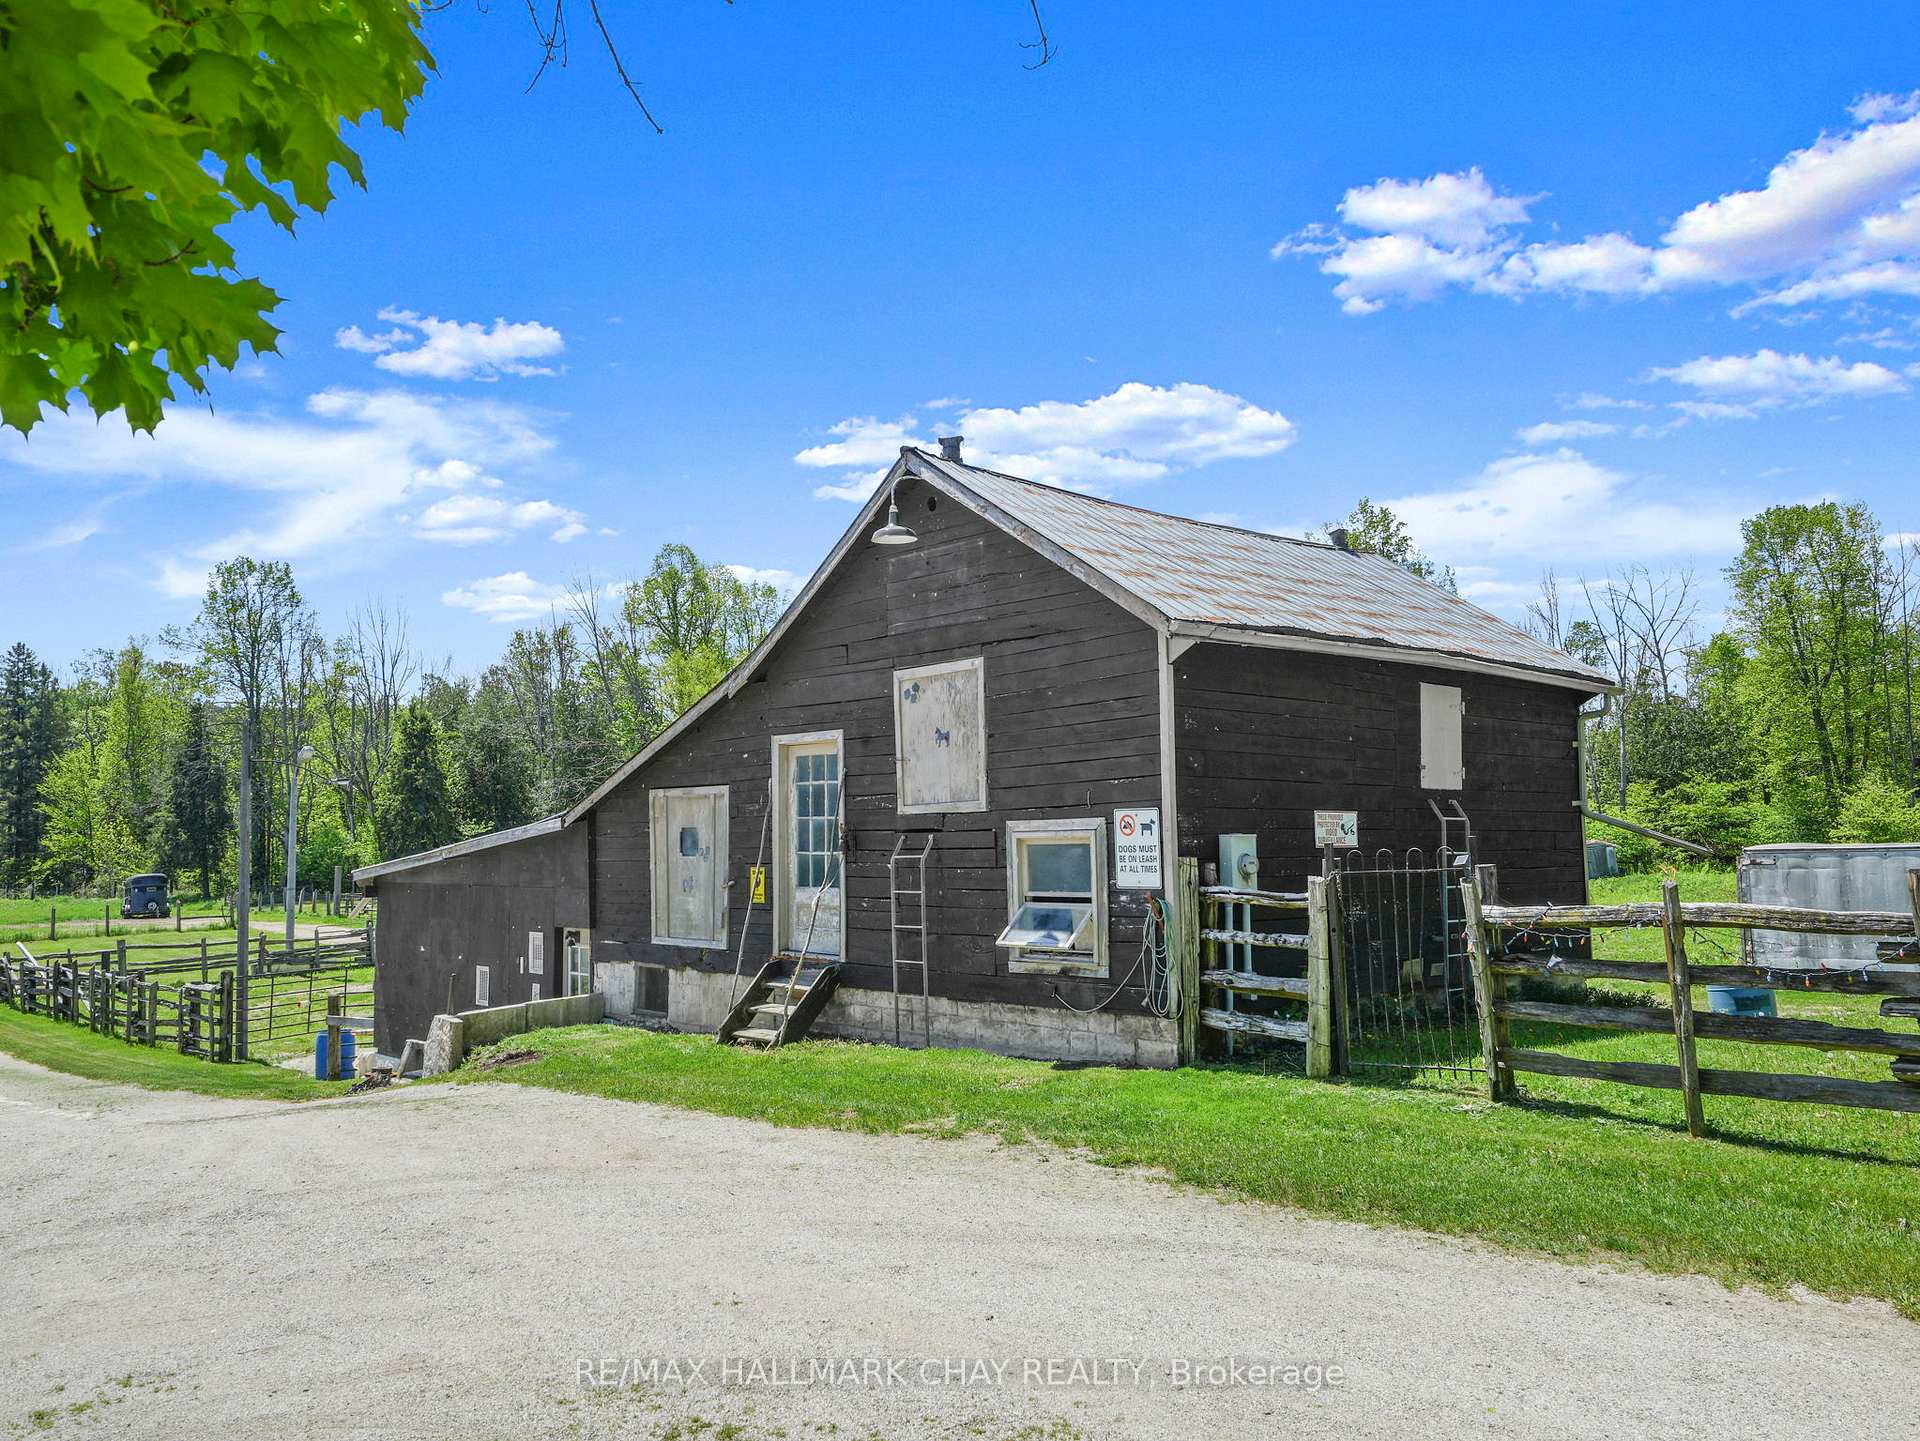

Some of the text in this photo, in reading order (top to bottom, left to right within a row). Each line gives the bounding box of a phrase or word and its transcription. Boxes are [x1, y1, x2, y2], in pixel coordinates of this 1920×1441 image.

[1118, 845, 1157, 853] DOGS MUST
[1119, 855, 1158, 863] BE ON LEASH
[1129, 865, 1139, 873] ALL
[1140, 865, 1158, 873] TIMES
